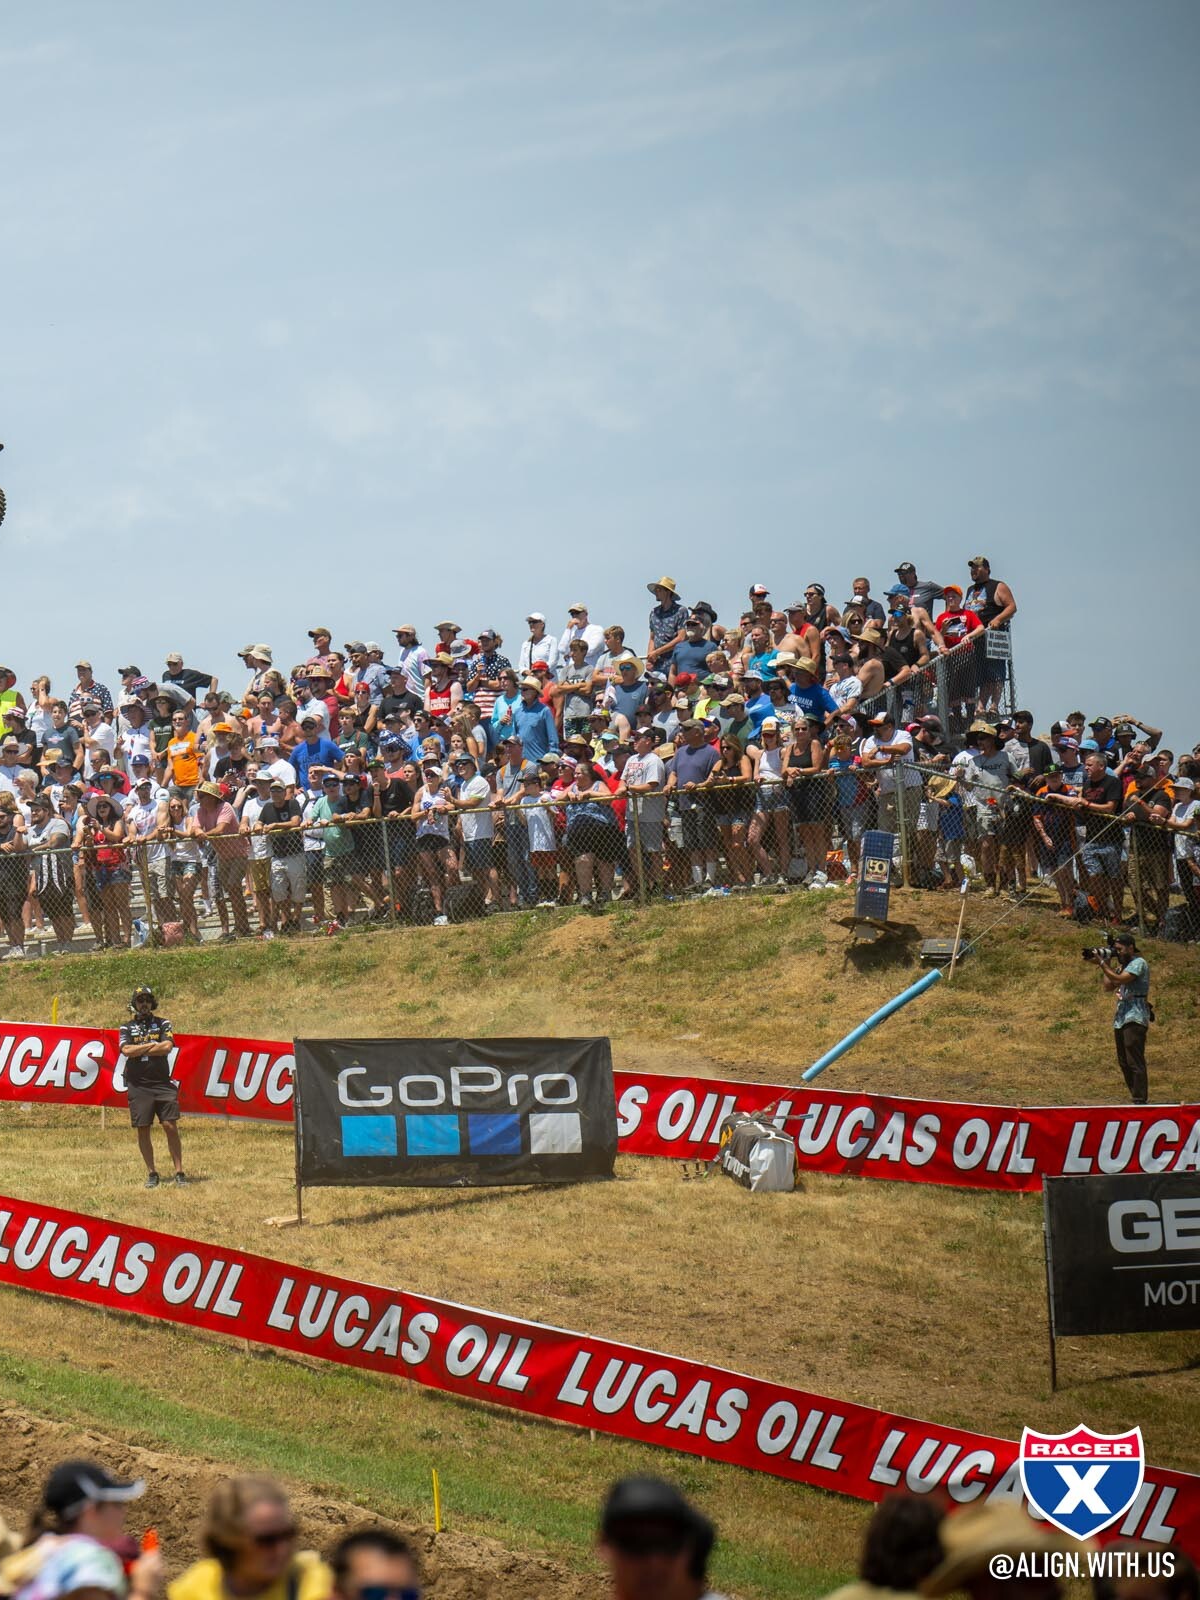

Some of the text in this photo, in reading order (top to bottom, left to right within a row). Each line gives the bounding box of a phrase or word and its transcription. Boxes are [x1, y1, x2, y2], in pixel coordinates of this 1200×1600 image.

[868, 859, 888, 875] 50
[336, 1066, 579, 1107] GoPro
[657, 1089, 738, 1144] OIL
[952, 1117, 1036, 1174] OIL
[1108, 1198, 1200, 1253] GE
[162, 1252, 244, 1317] OIL
[267, 1277, 439, 1365] LUCAS
[445, 1322, 533, 1392] OIL
[557, 1350, 749, 1443] LUCAS
[756, 1400, 846, 1471] OIL
[869, 1429, 1050, 1520] LUCA
[1118, 1481, 1178, 1544] IL
